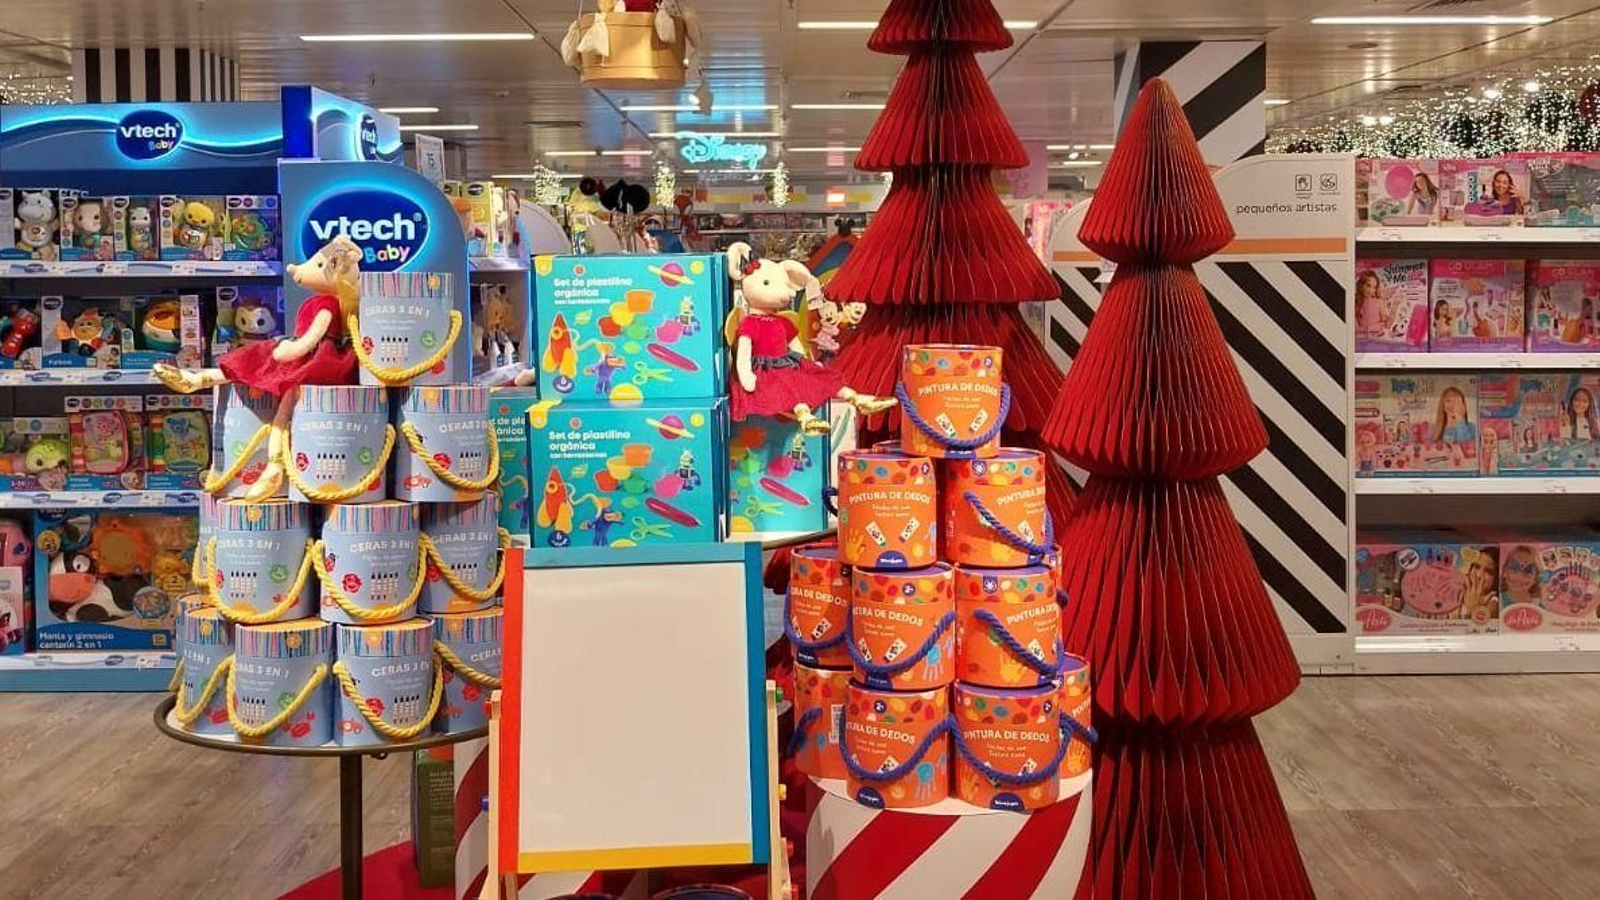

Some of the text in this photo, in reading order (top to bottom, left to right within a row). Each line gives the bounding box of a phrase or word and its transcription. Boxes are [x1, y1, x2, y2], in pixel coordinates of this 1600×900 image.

[121, 122, 177, 138] vtech
[149, 140, 174, 151] Baby
[675, 131, 767, 170] Disney
[1236, 201, 1337, 214] pequeños artistas
[309, 212, 416, 240] vtech
[364, 243, 411, 263] Baby
[554, 278, 570, 287] Set
[586, 277, 633, 288] plastilina
[554, 288, 599, 298] orgánica
[408, 306, 424, 316] EN
[918, 383, 959, 397] PINTURA
[959, 382, 974, 392] DE
[346, 422, 361, 432] EN
[549, 429, 631, 441] Set de plastilina
[549, 441, 596, 452] orgánica
[849, 491, 887, 504] PINTURA
[889, 491, 902, 500] DE
[349, 540, 389, 553] CERAS
[815, 591, 848, 607] DEDOS
[874, 608, 887, 618] DE
[888, 610, 924, 626] DEDOS
[1006, 605, 1046, 625] PINTURA
[40, 632, 65, 640] Manta
[265, 666, 281, 677] EN
[371, 663, 410, 677] CERAS
[866, 724, 879, 735] DE
[880, 728, 917, 745] DEDOS
[1003, 730, 1018, 740] DE
